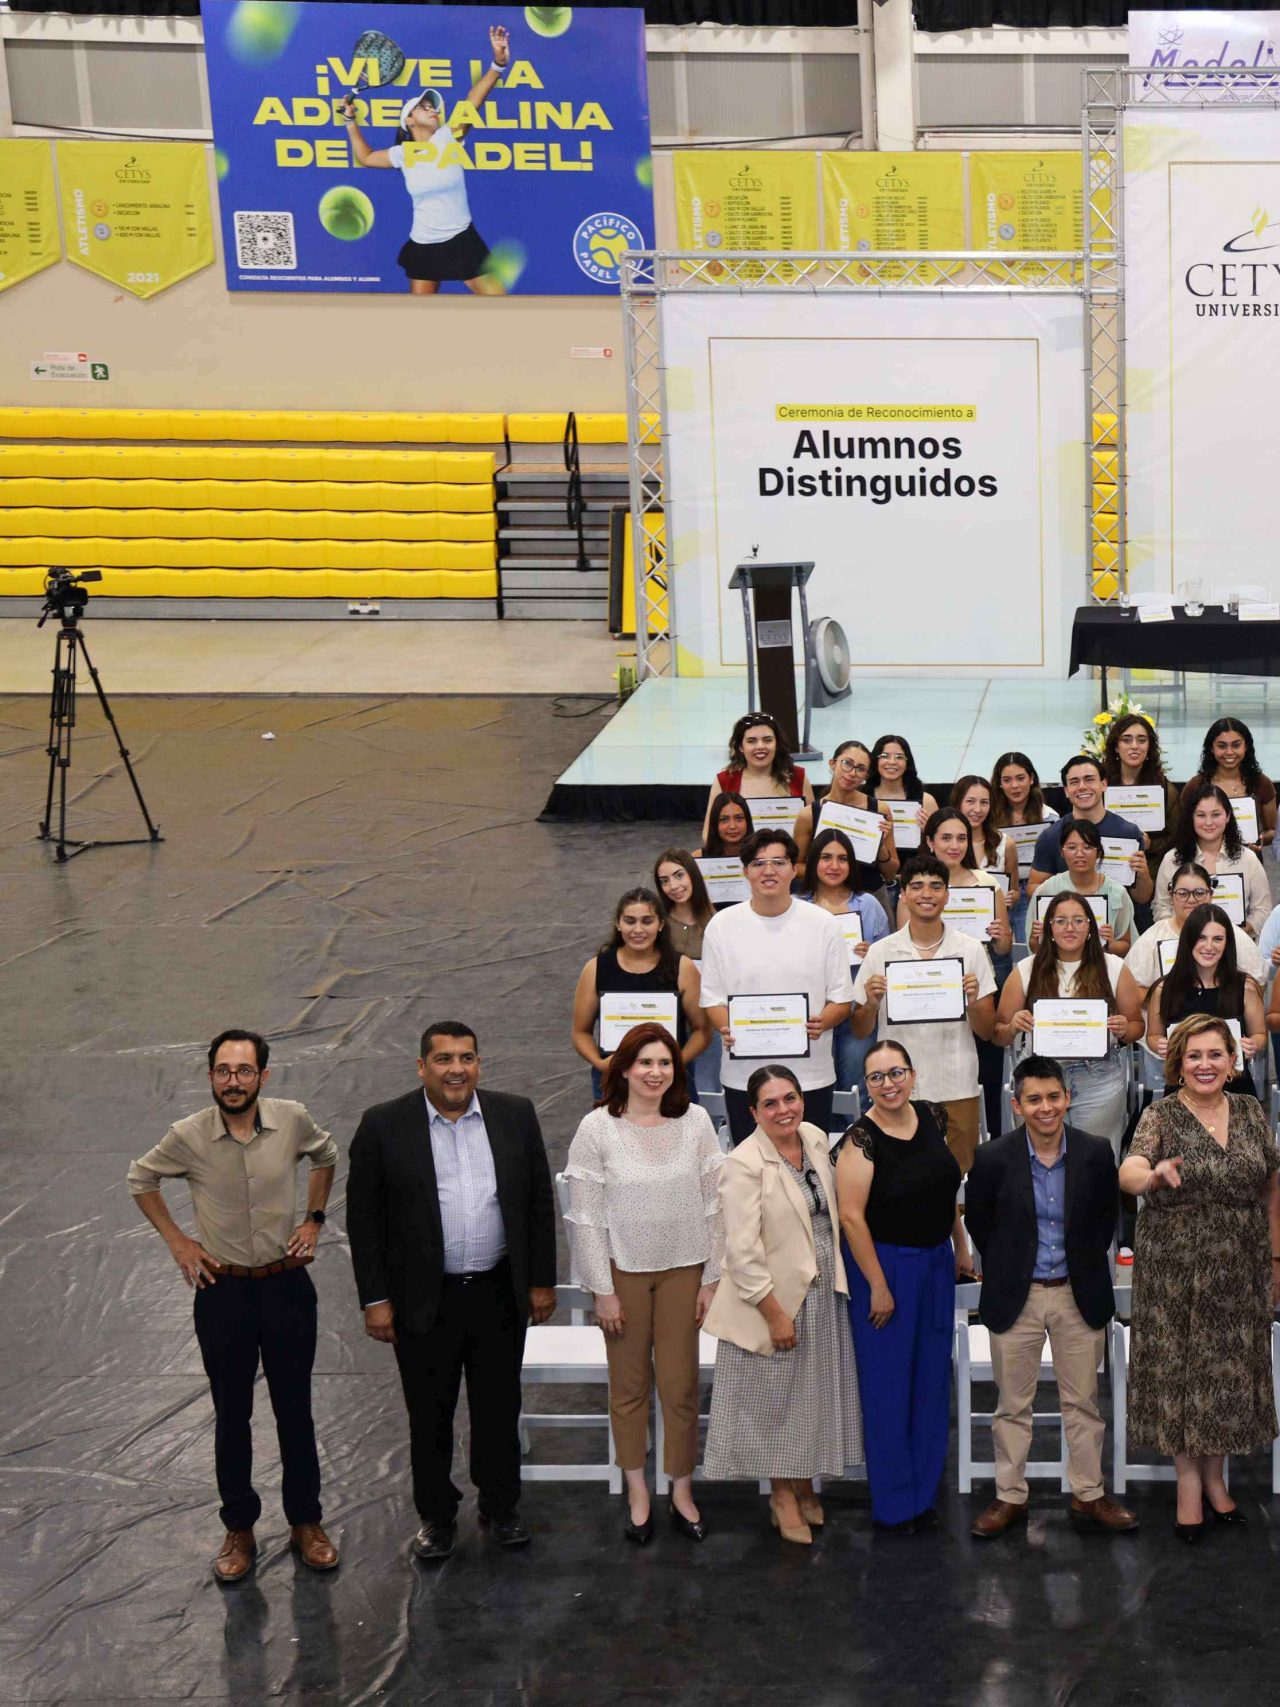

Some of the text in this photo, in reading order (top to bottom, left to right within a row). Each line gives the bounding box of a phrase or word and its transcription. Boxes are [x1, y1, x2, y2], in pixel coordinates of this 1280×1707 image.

[315, 57, 544, 96] ¡VIVE LA
[252, 96, 614, 131] ADREALINA
[274, 138, 370, 169] DE
[115, 169, 152, 179] CETYS
[729, 177, 763, 188] CETYS
[875, 178, 911, 188] CETYS
[1023, 173, 1057, 183] CETYS
[74, 188, 90, 256] ATLETISMO
[691, 197, 703, 249] LETISMO
[840, 198, 850, 251] LETISMO
[127, 272, 160, 283] 2021
[579, 252, 612, 279] PADEL
[778, 406, 974, 418] Ceremonia de Reconocimiento a
[792, 429, 963, 459] Alumnos
[758, 467, 998, 505] Distinguidos
